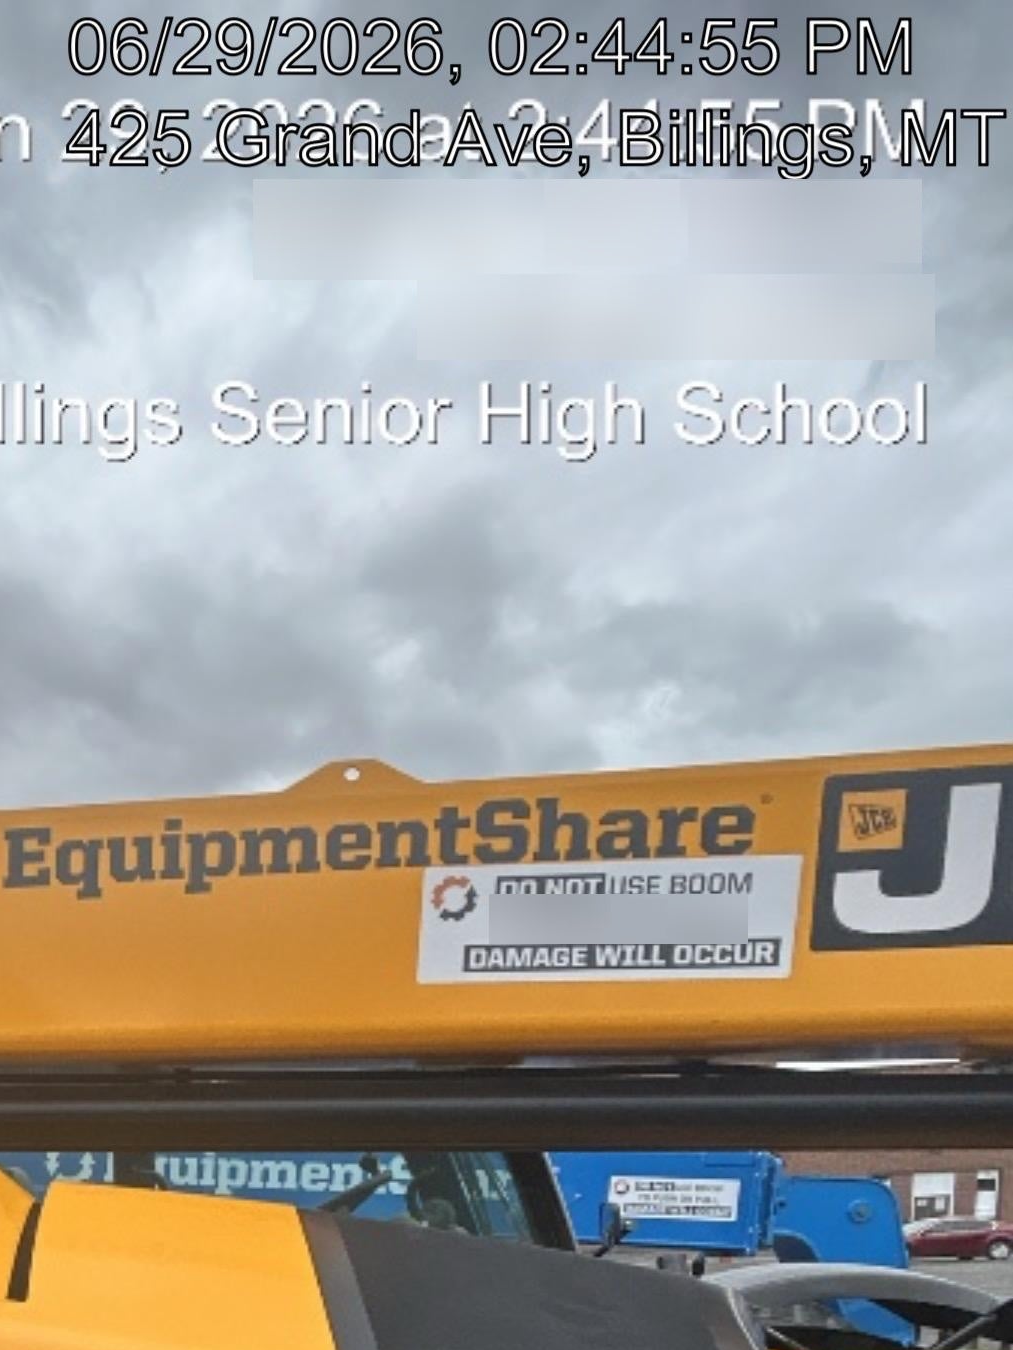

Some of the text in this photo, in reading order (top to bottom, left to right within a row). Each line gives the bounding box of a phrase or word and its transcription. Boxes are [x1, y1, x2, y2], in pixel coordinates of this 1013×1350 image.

[2, 799, 756, 900] EquipmentShare
[609, 875, 661, 895] USE
[669, 872, 754, 895] BOOM
[468, 942, 775, 970] DAMAGE WILL OCCUR
